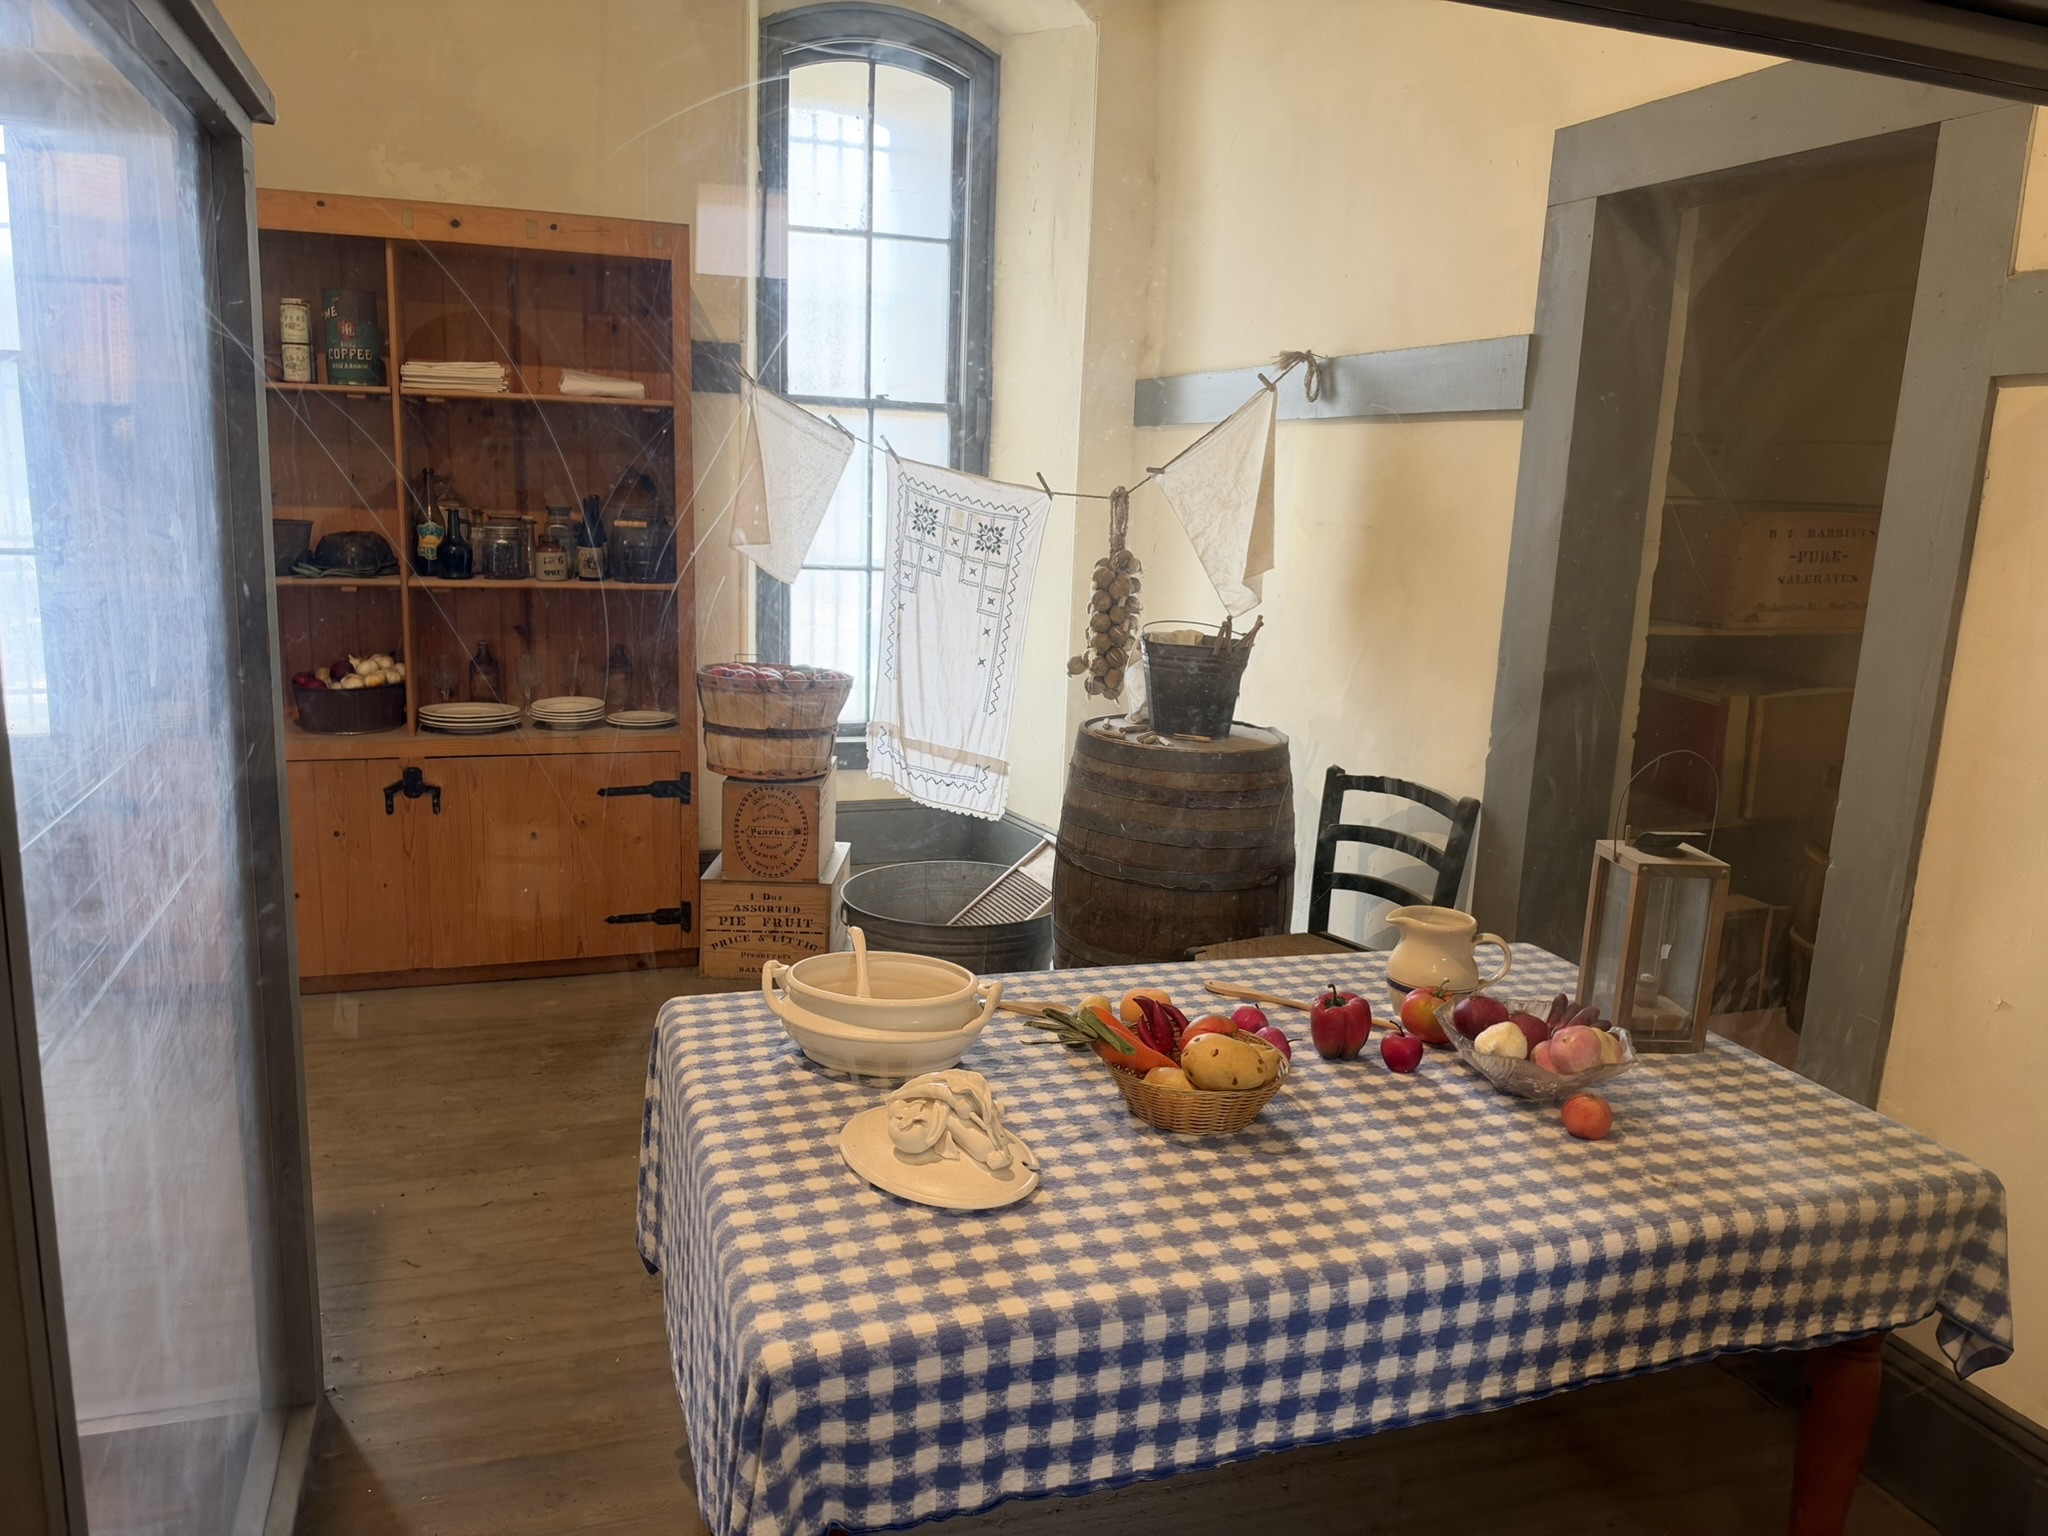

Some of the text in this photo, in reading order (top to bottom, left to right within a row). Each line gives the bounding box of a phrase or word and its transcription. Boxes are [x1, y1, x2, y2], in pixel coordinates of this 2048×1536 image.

[322, 305, 337, 320] ME
[328, 348, 373, 361] COFFEE
[750, 827, 792, 836] Peaches
[754, 860, 787, 870] BOSTON
[733, 904, 801, 914] ASSORTED
[719, 916, 814, 928] PIE FRUIT
[711, 934, 819, 952] PRICE & LITTIG
[739, 966, 763, 974] BALT
